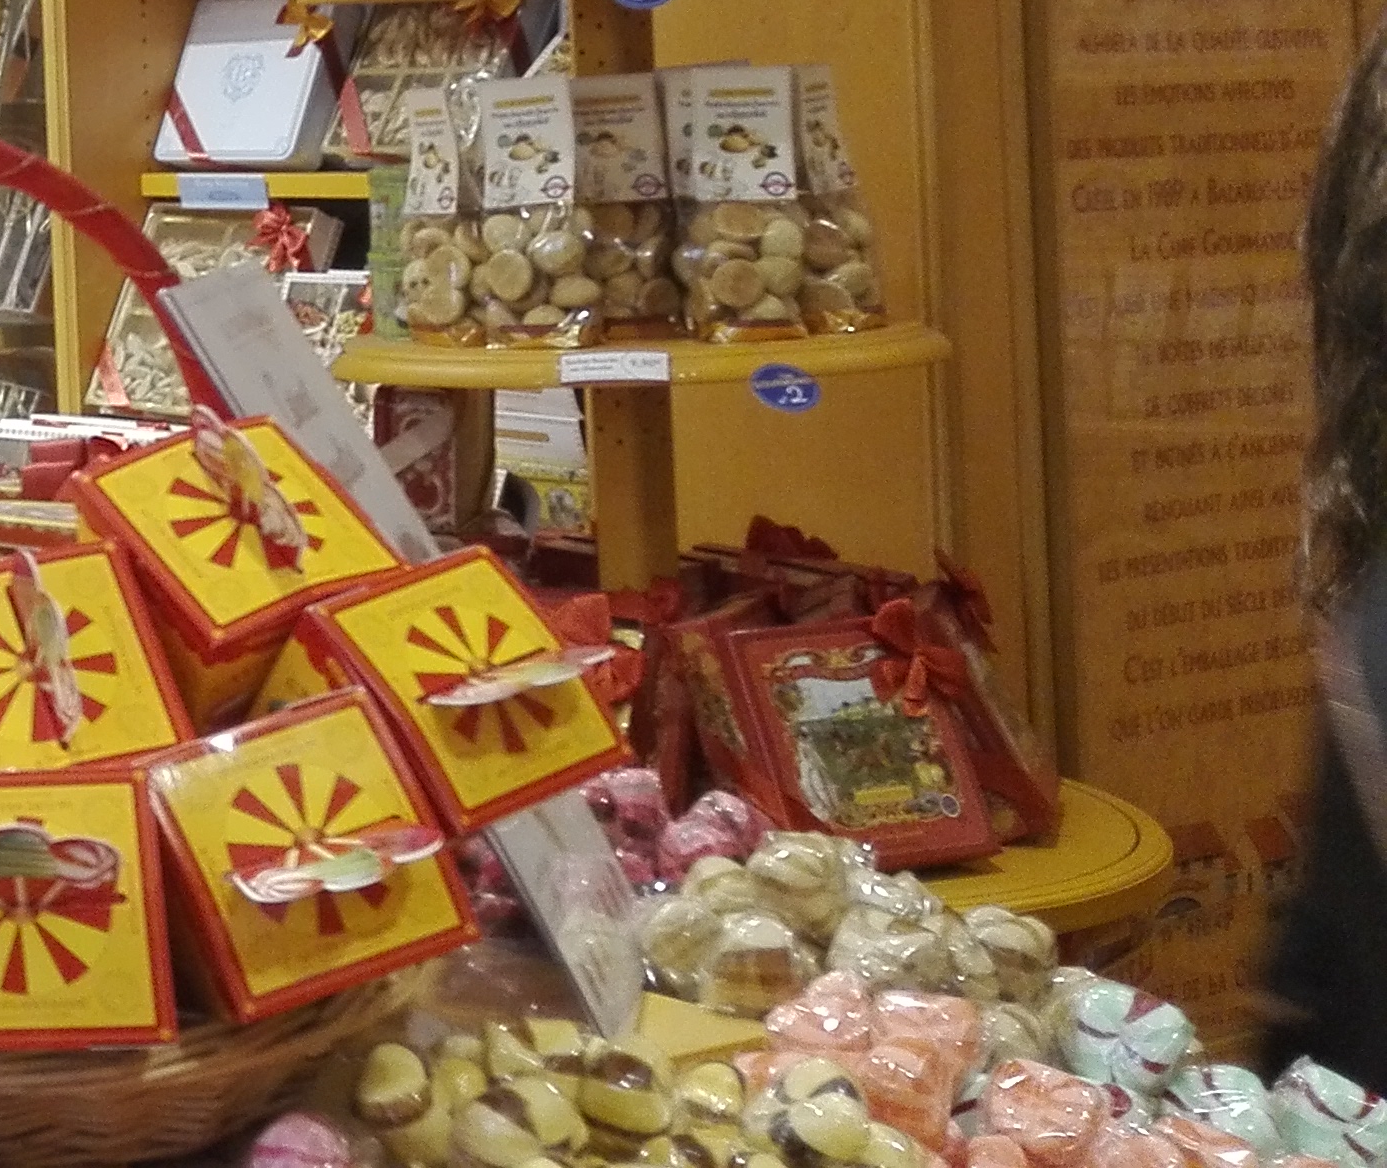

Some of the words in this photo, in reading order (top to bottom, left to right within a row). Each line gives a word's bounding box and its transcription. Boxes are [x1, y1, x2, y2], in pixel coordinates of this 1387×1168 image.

[1115, 84, 1138, 107] LES
[1129, 233, 1151, 262] LA
[1157, 230, 1197, 260] CURE
[1098, 559, 1121, 585] LES
